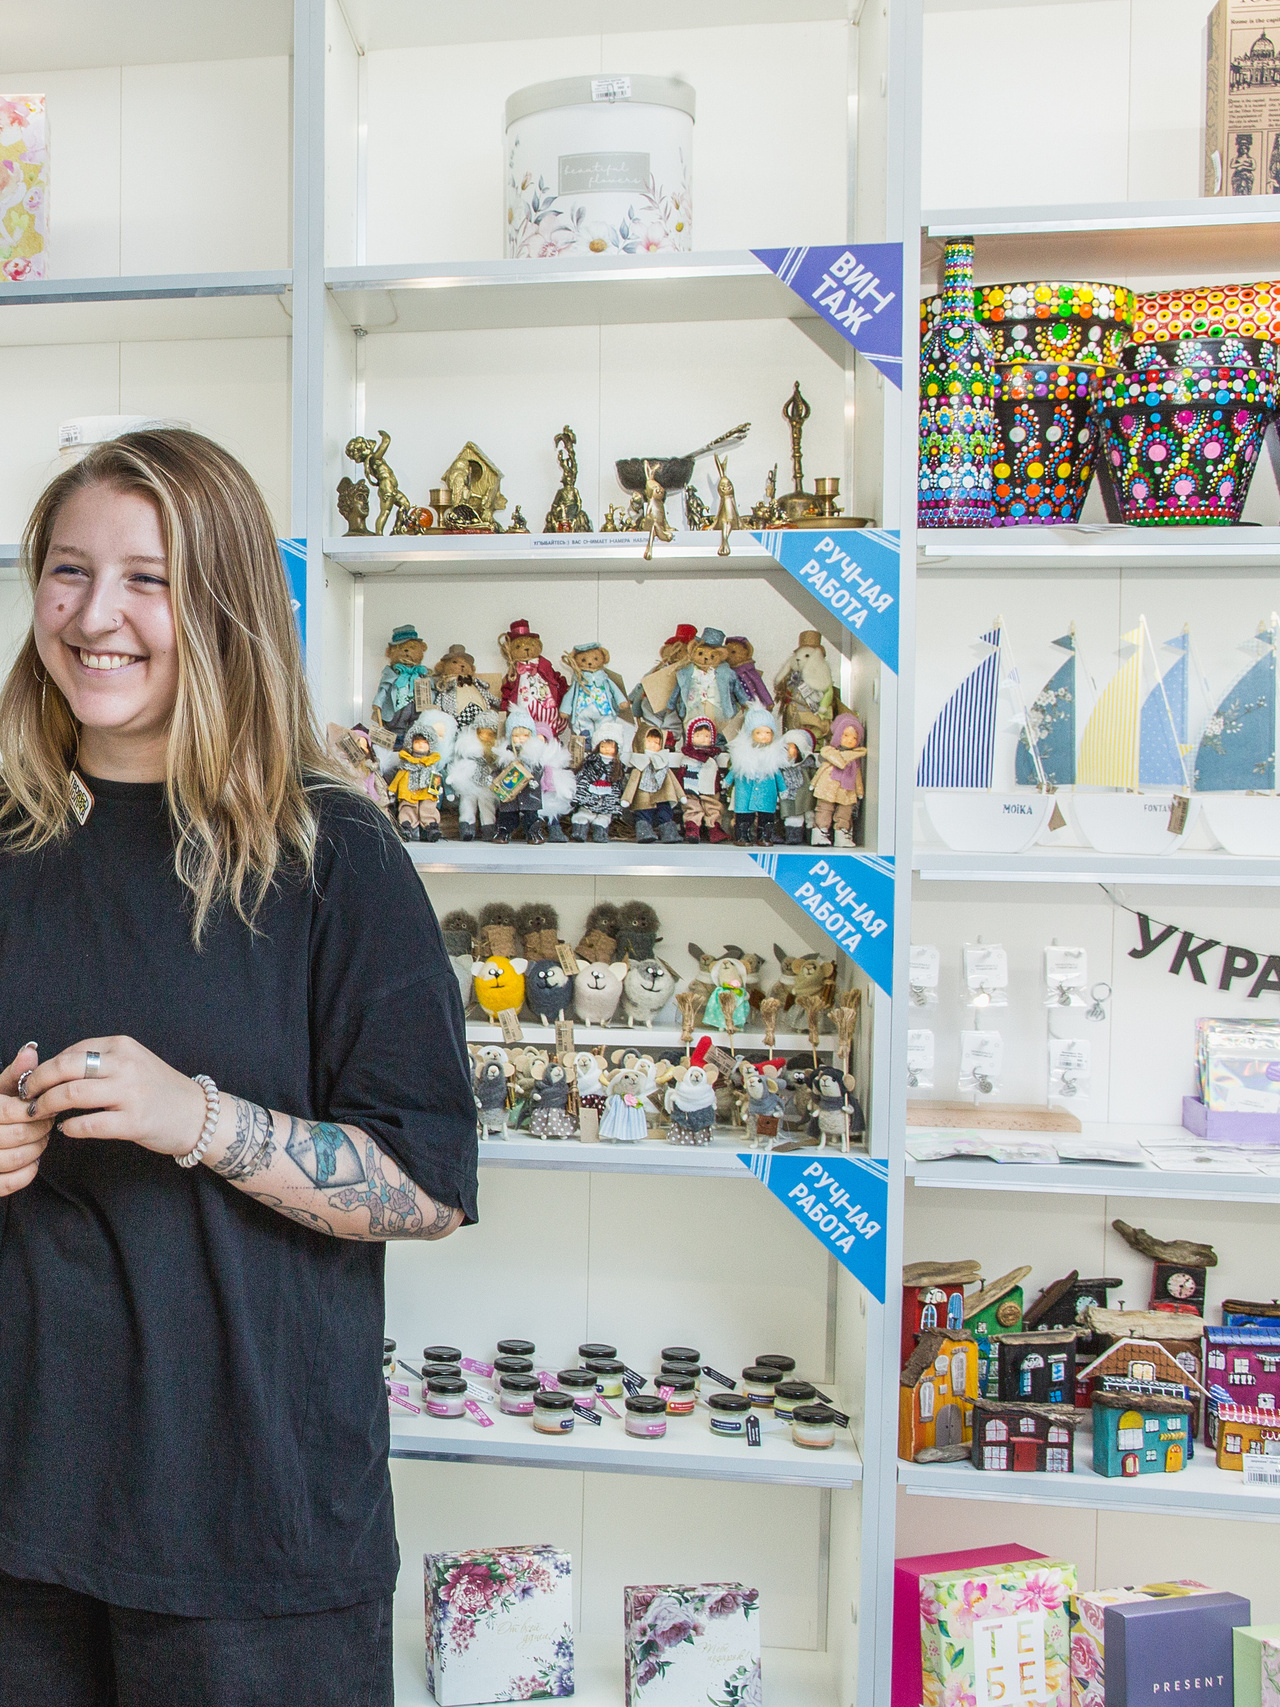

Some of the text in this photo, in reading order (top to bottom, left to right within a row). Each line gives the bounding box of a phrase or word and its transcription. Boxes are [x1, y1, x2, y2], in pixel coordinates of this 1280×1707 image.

[811, 273, 874, 336] ТАЖ
[828, 250, 896, 314] ВИН
[799, 559, 869, 629] РАБОТА
[813, 536, 894, 614] РУЧНАЯ
[793, 881, 863, 953] РАБОТА
[808, 859, 889, 939] РУЧНАЯ
[787, 1182, 856, 1254] РАБОТА
[802, 1161, 882, 1240] РУЧНАЯ
[1153, 1675, 1224, 1694] PRESENT
